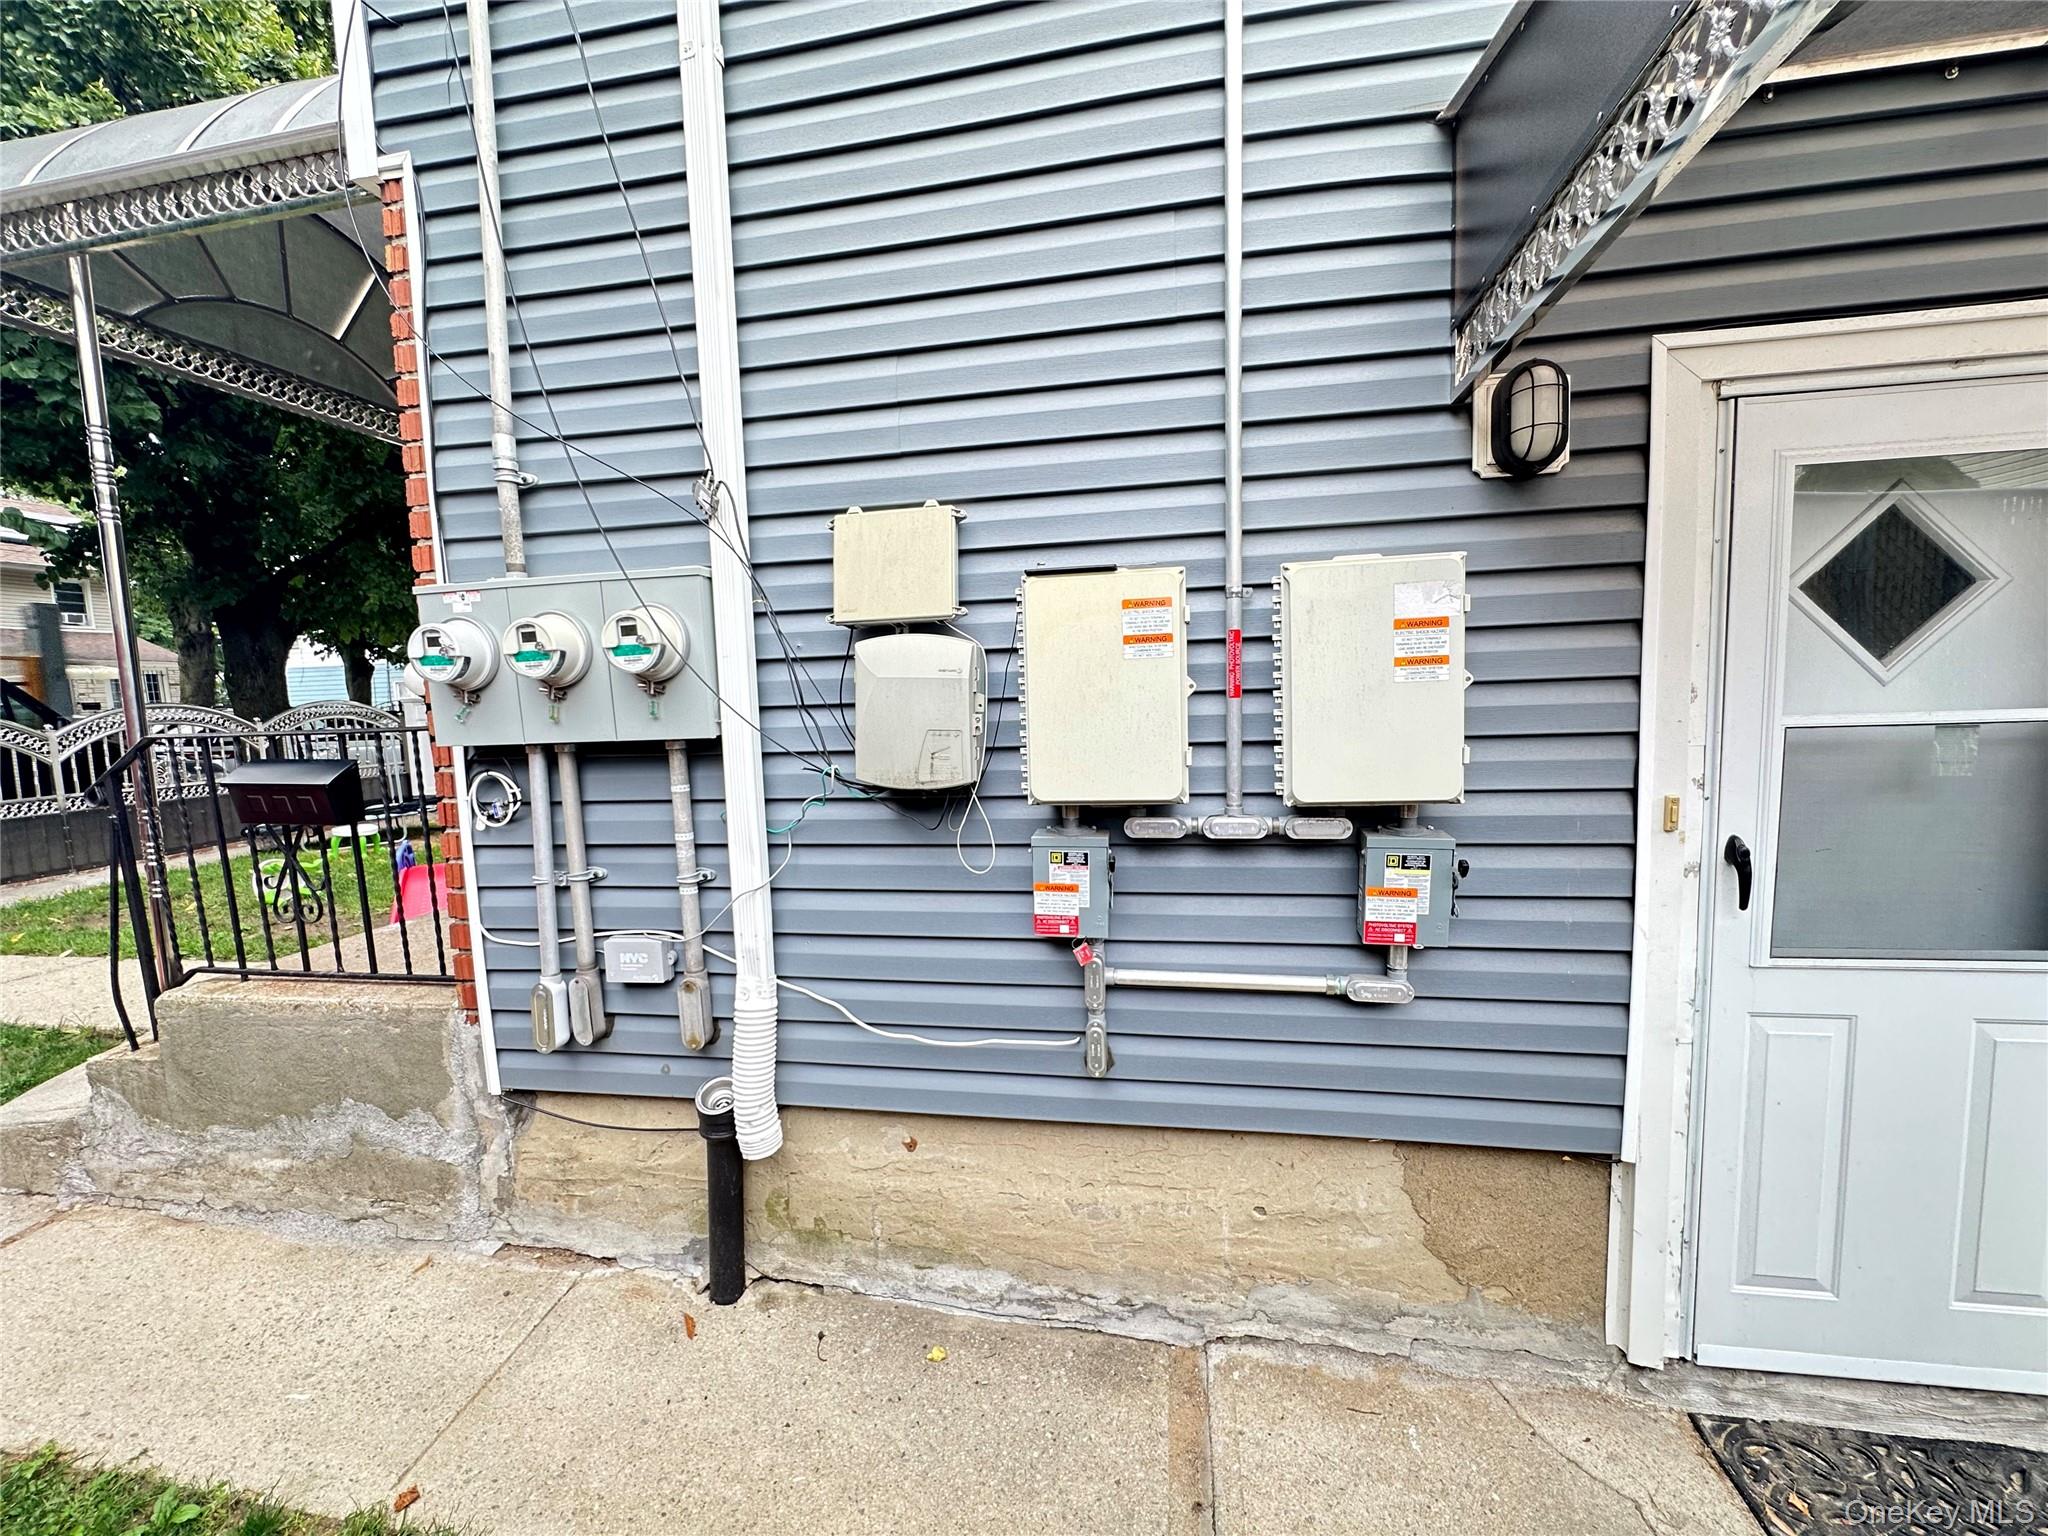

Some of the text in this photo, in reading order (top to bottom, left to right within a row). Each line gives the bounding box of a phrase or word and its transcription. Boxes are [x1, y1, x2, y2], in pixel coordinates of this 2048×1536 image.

[1134, 600, 1166, 608] WARNING
[1407, 620, 1443, 628] WARNING
[1135, 636, 1168, 644] WARNING
[620, 952, 649, 964] NYC
